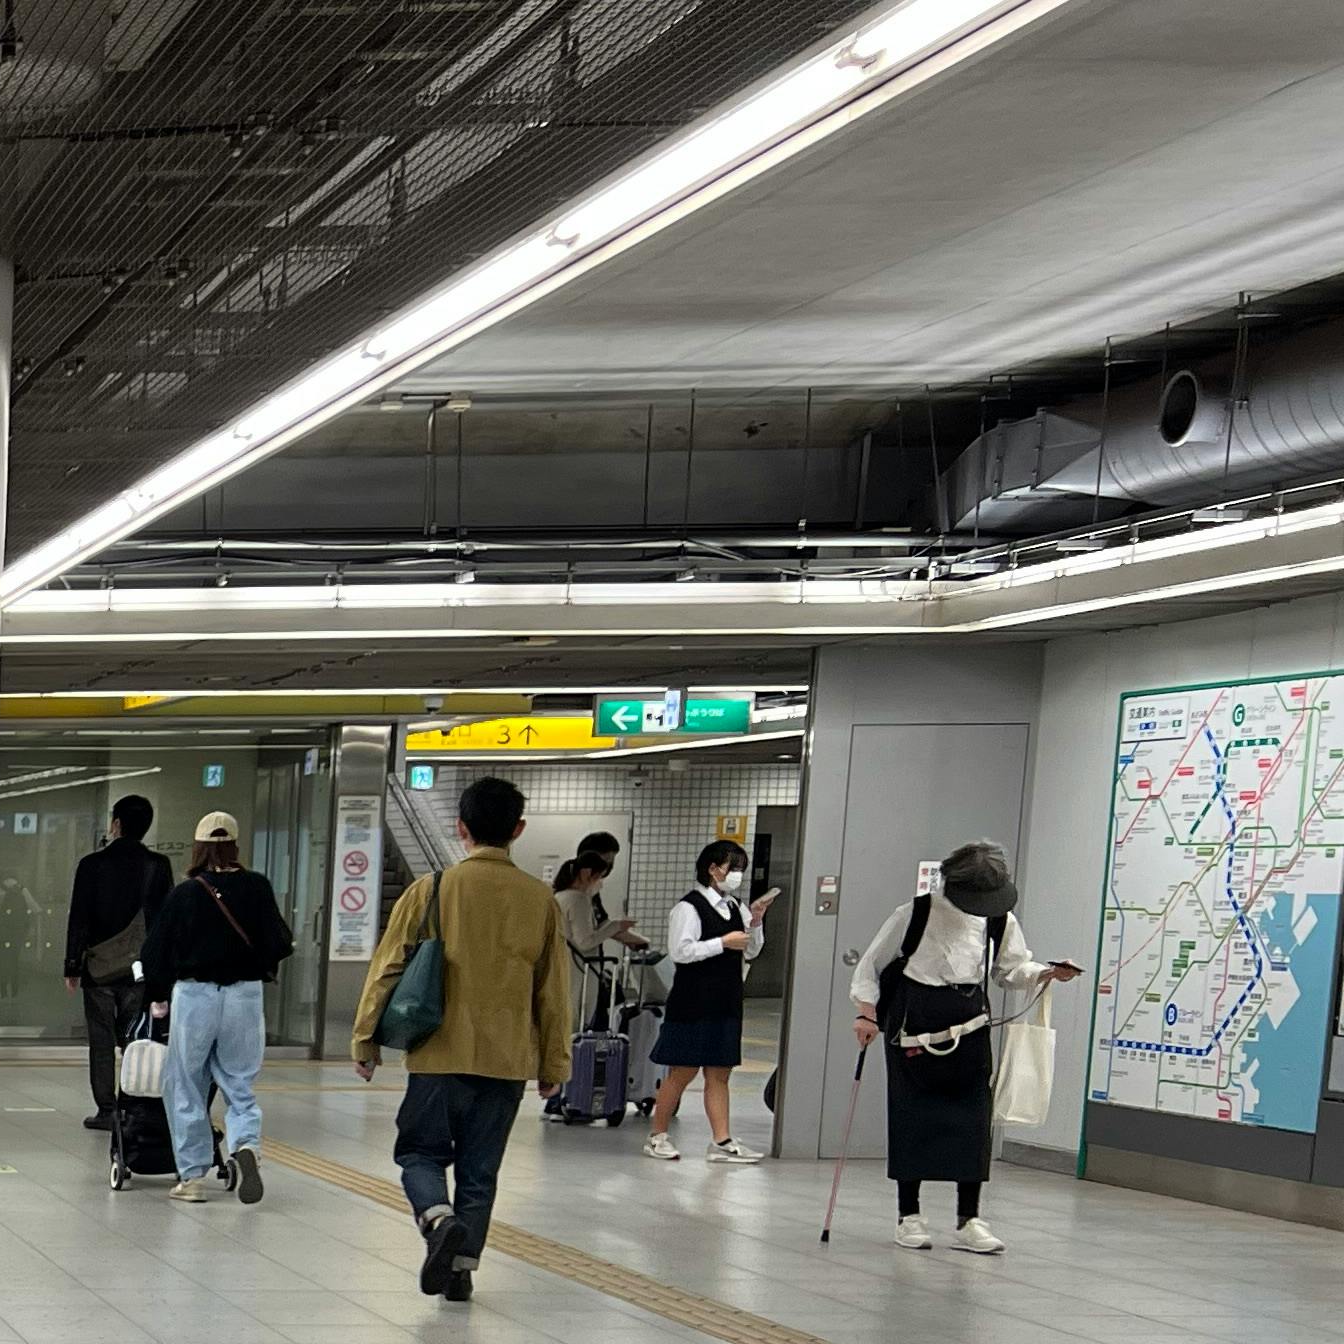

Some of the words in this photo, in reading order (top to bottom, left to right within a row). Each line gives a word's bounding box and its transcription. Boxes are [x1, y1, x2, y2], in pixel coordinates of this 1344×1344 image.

[1234, 706, 1244, 722] G
[497, 724, 511, 745] 3
[1168, 1008, 1175, 1022] B
